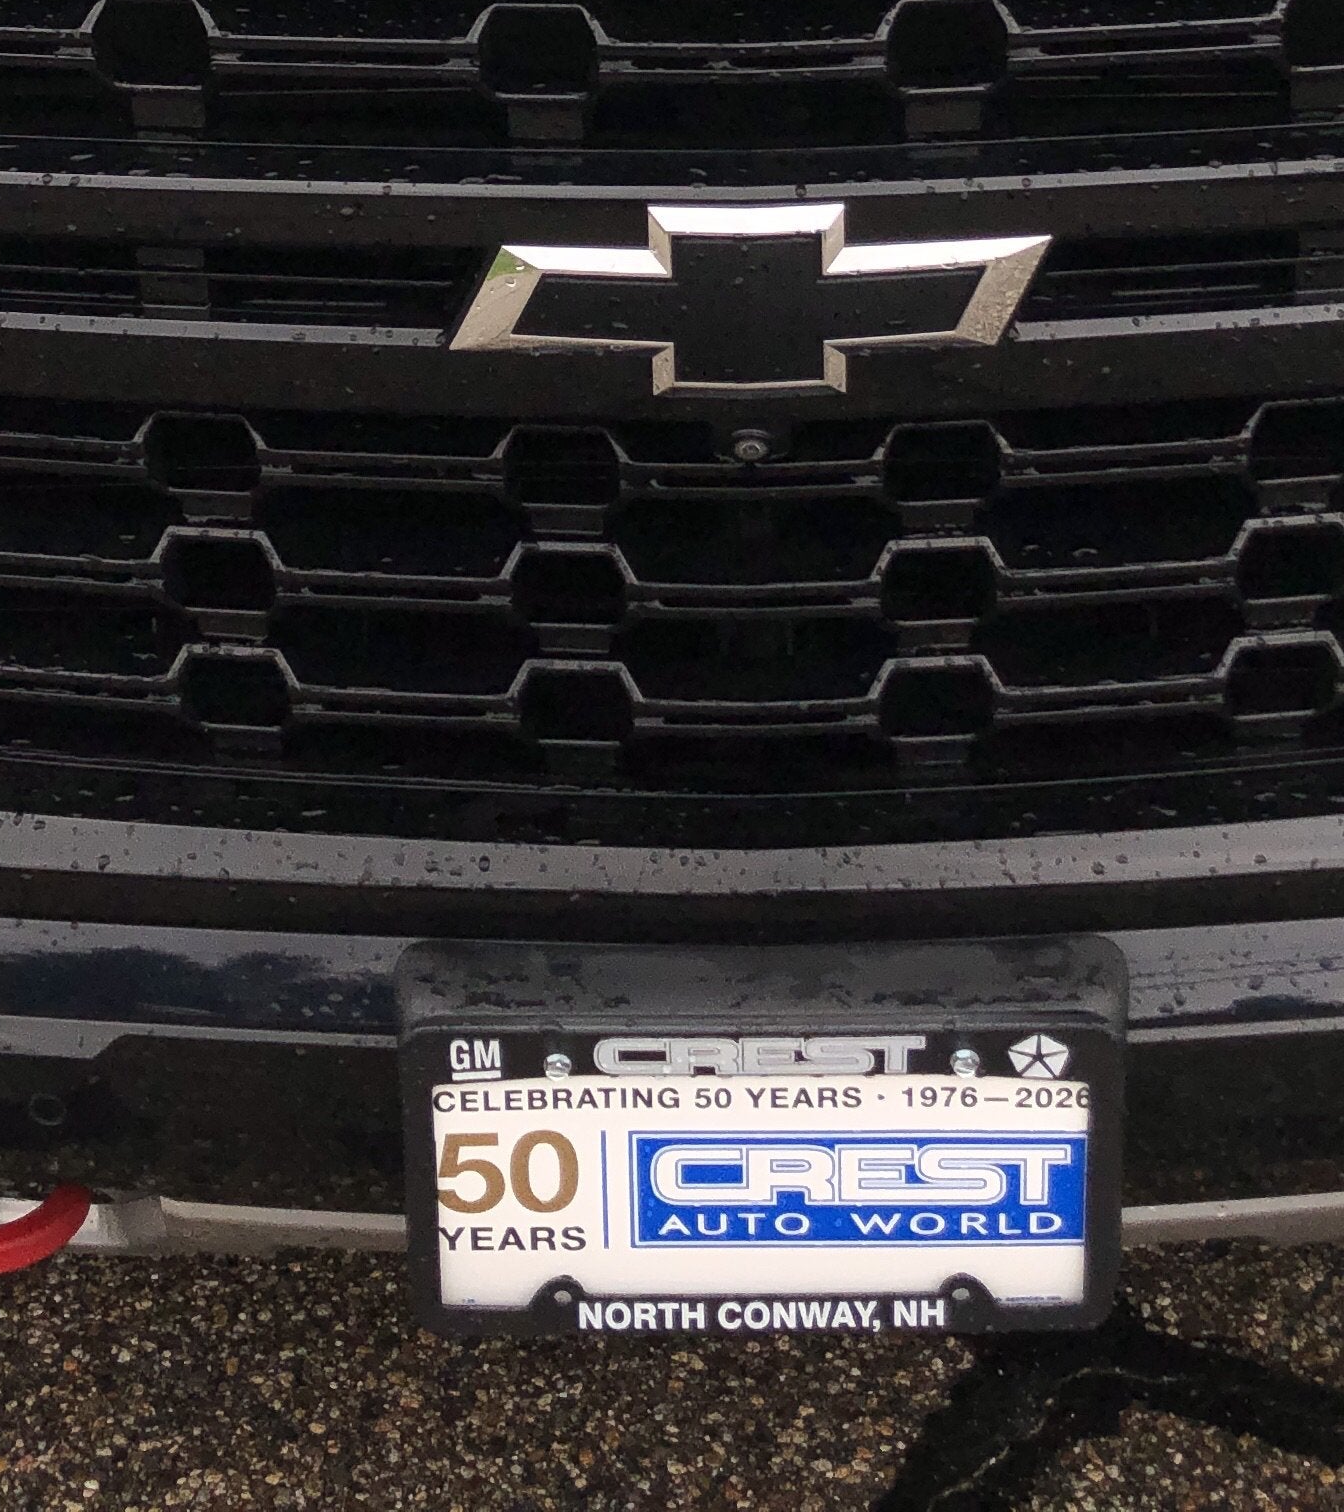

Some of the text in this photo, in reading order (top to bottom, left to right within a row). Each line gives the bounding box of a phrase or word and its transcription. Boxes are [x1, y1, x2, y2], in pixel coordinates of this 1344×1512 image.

[449, 1038, 502, 1071] GM
[593, 1035, 927, 1076] CREST
[433, 1087, 681, 1113] CELEBRATING
[693, 1087, 733, 1110] 50
[745, 1086, 863, 1109] YEARS
[437, 1129, 580, 1214] 50
[650, 1143, 1072, 1207] CREST
[438, 1225, 587, 1252] YEARS
[657, 1211, 1064, 1237] AUTO WORLD
[577, 1298, 946, 1333] NORTH CONWAY, NH
